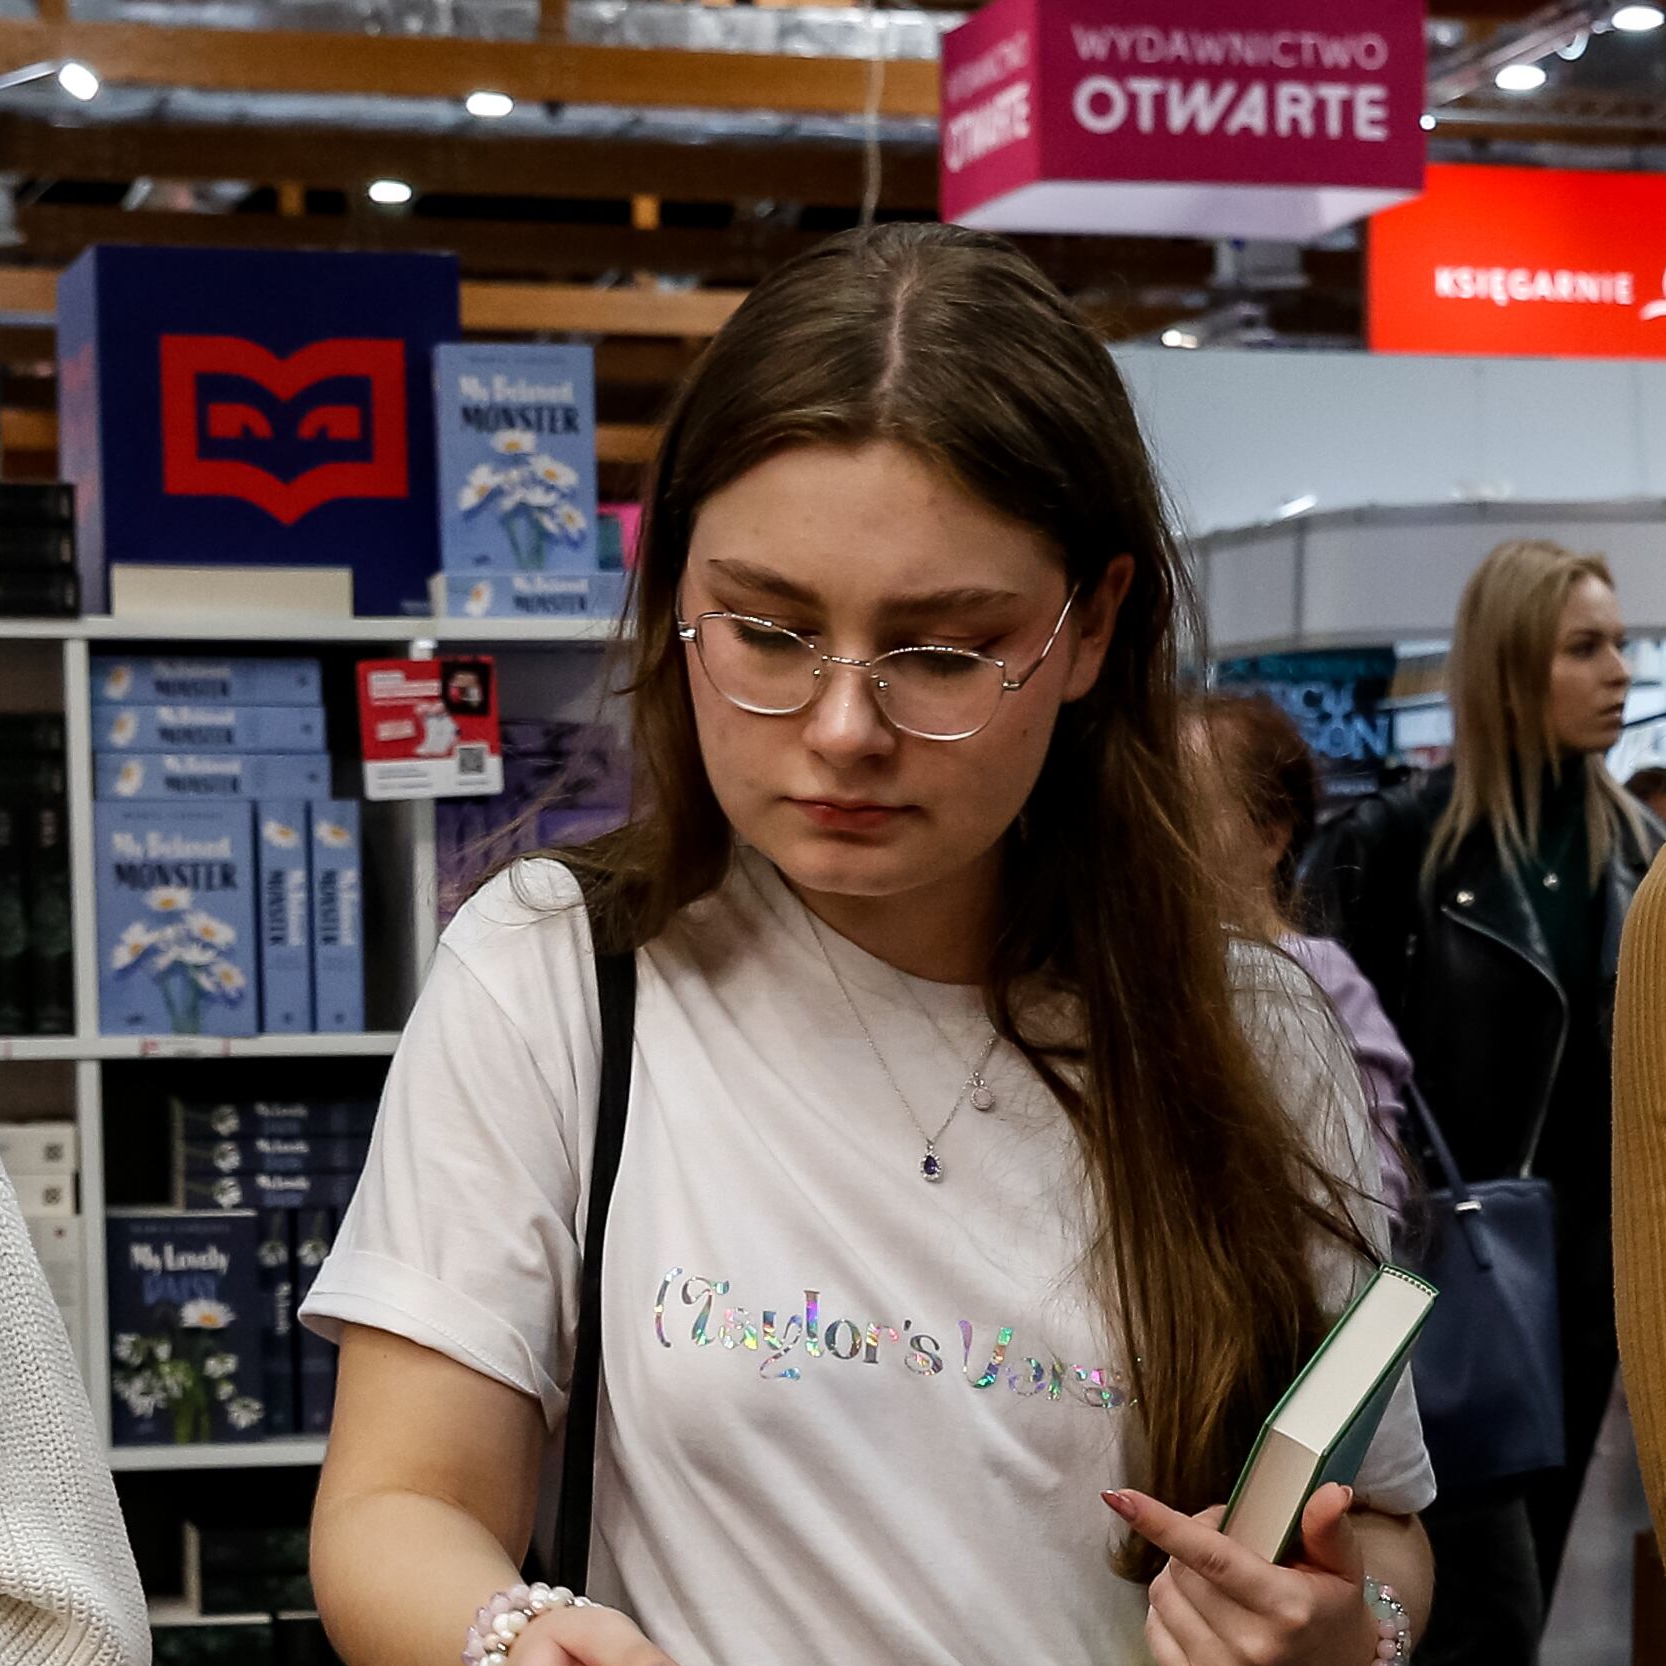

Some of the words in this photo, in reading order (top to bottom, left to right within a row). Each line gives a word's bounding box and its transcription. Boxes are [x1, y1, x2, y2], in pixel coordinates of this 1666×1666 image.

[1072, 23, 1390, 71] WYDAWNICTWO
[1071, 74, 1390, 142] OTWARTE
[1433, 263, 1635, 307] KSIĘGARNIE
[130, 1242, 161, 1276] My
[164, 1242, 231, 1275] Lovely
